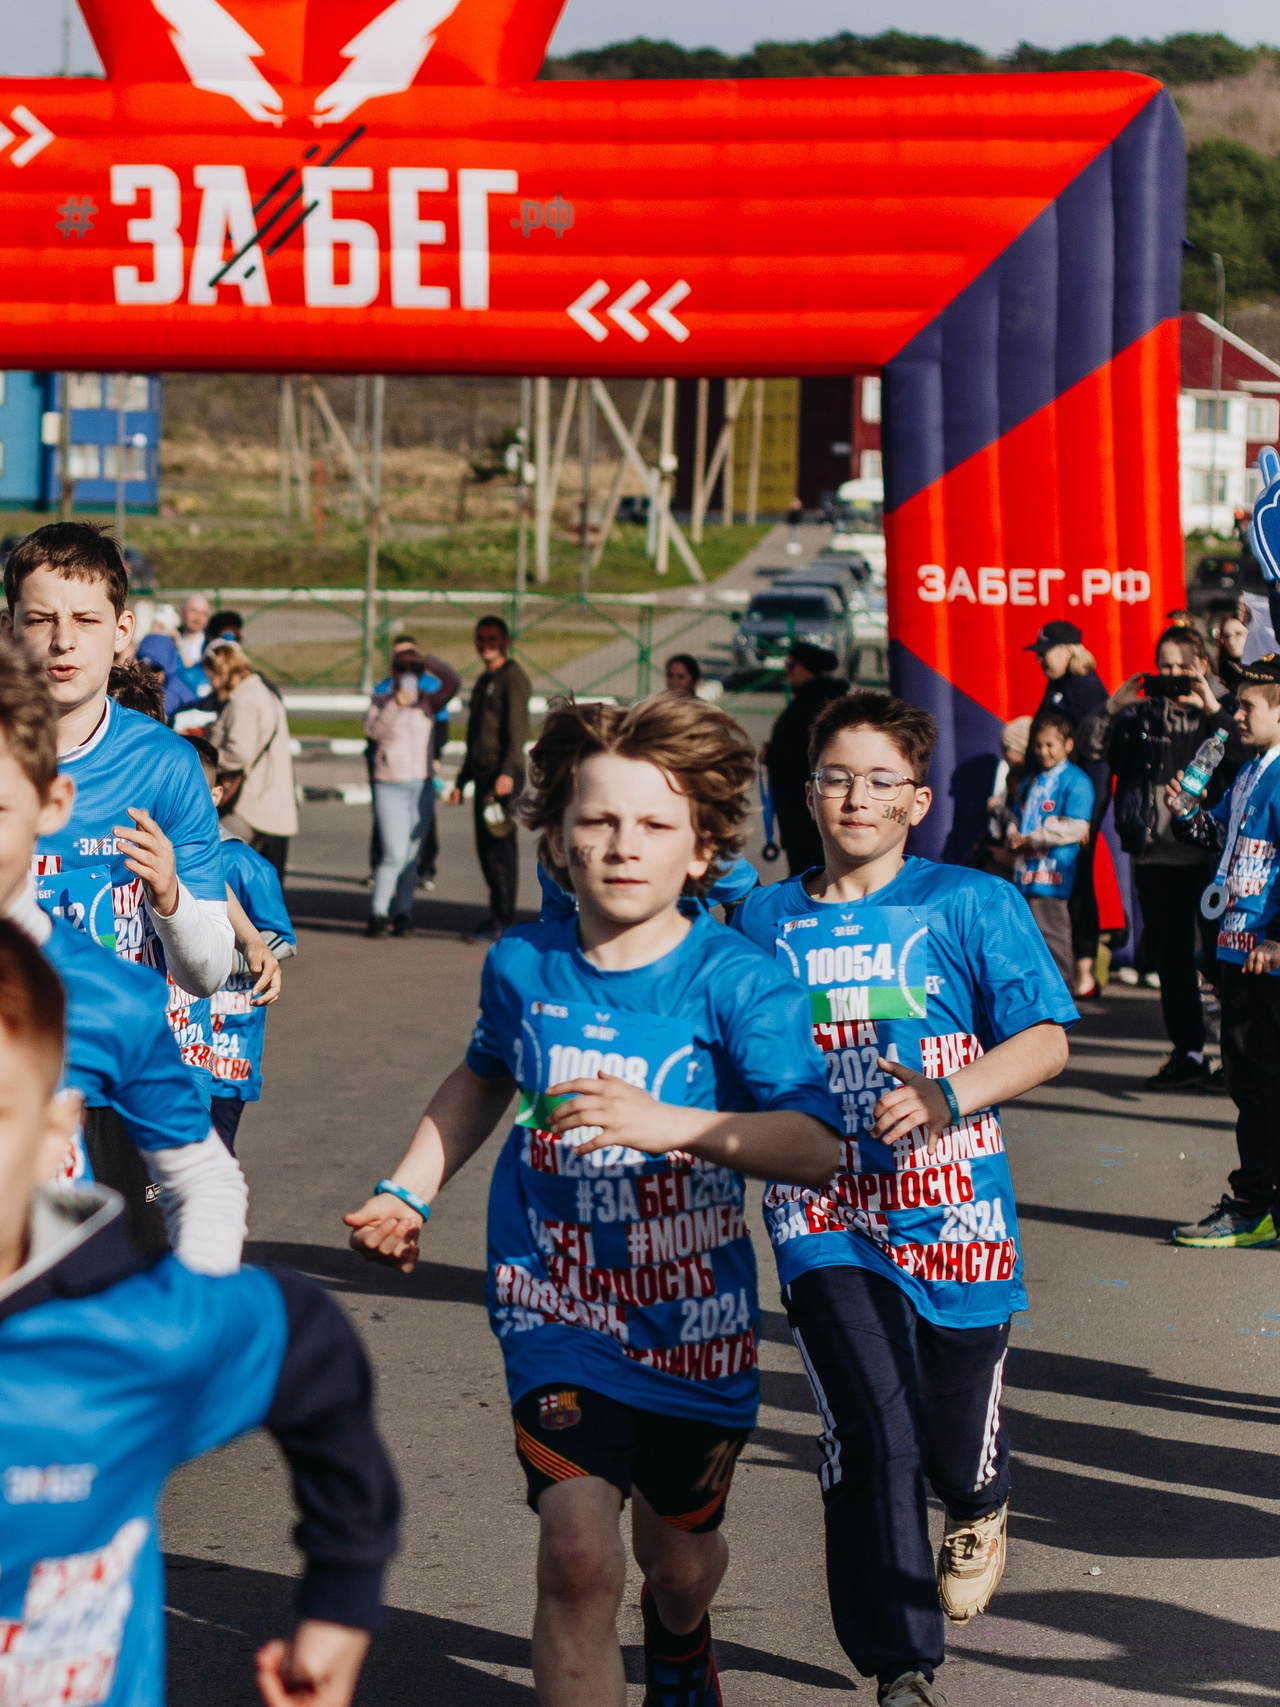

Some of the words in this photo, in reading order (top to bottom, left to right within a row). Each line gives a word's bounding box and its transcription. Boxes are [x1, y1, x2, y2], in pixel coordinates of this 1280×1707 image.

[916, 563, 1152, 606] ЗАБЕГ.РФ
[805, 943, 896, 986] 10054
[825, 986, 870, 1023] 1КМ
[938, 1197, 1007, 1242] 2024
[680, 1288, 751, 1342] 2024
